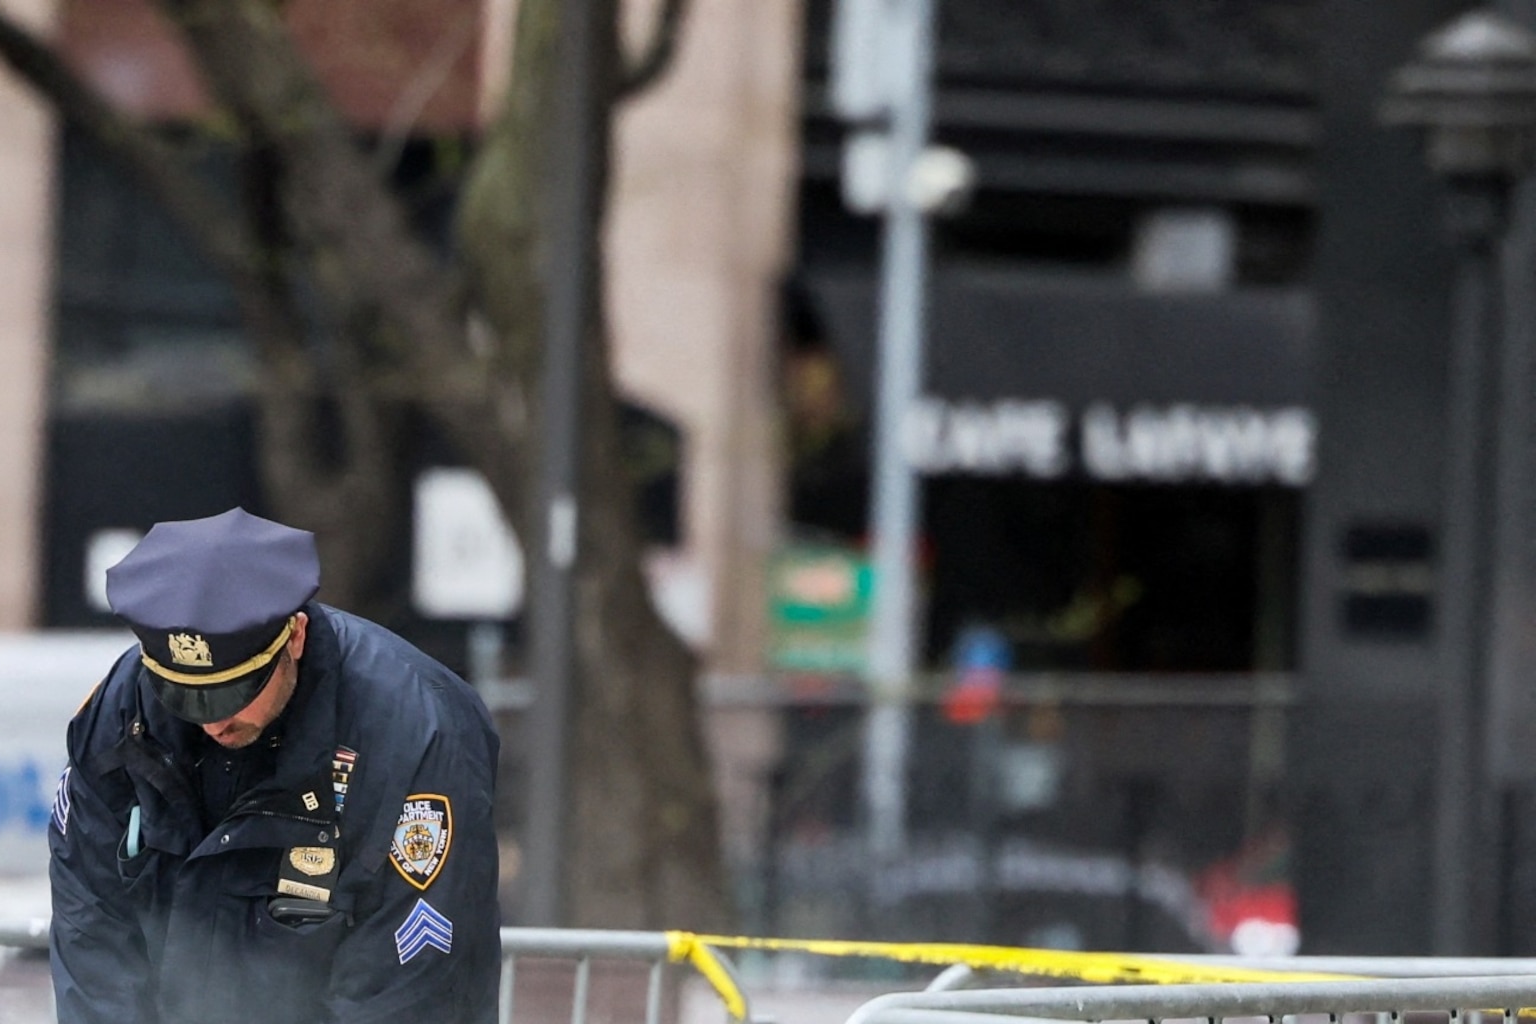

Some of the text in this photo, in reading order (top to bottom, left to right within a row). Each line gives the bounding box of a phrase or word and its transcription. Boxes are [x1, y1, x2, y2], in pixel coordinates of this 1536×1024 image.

[402, 861, 415, 874] OF
[424, 829, 448, 876] NEW YORK
